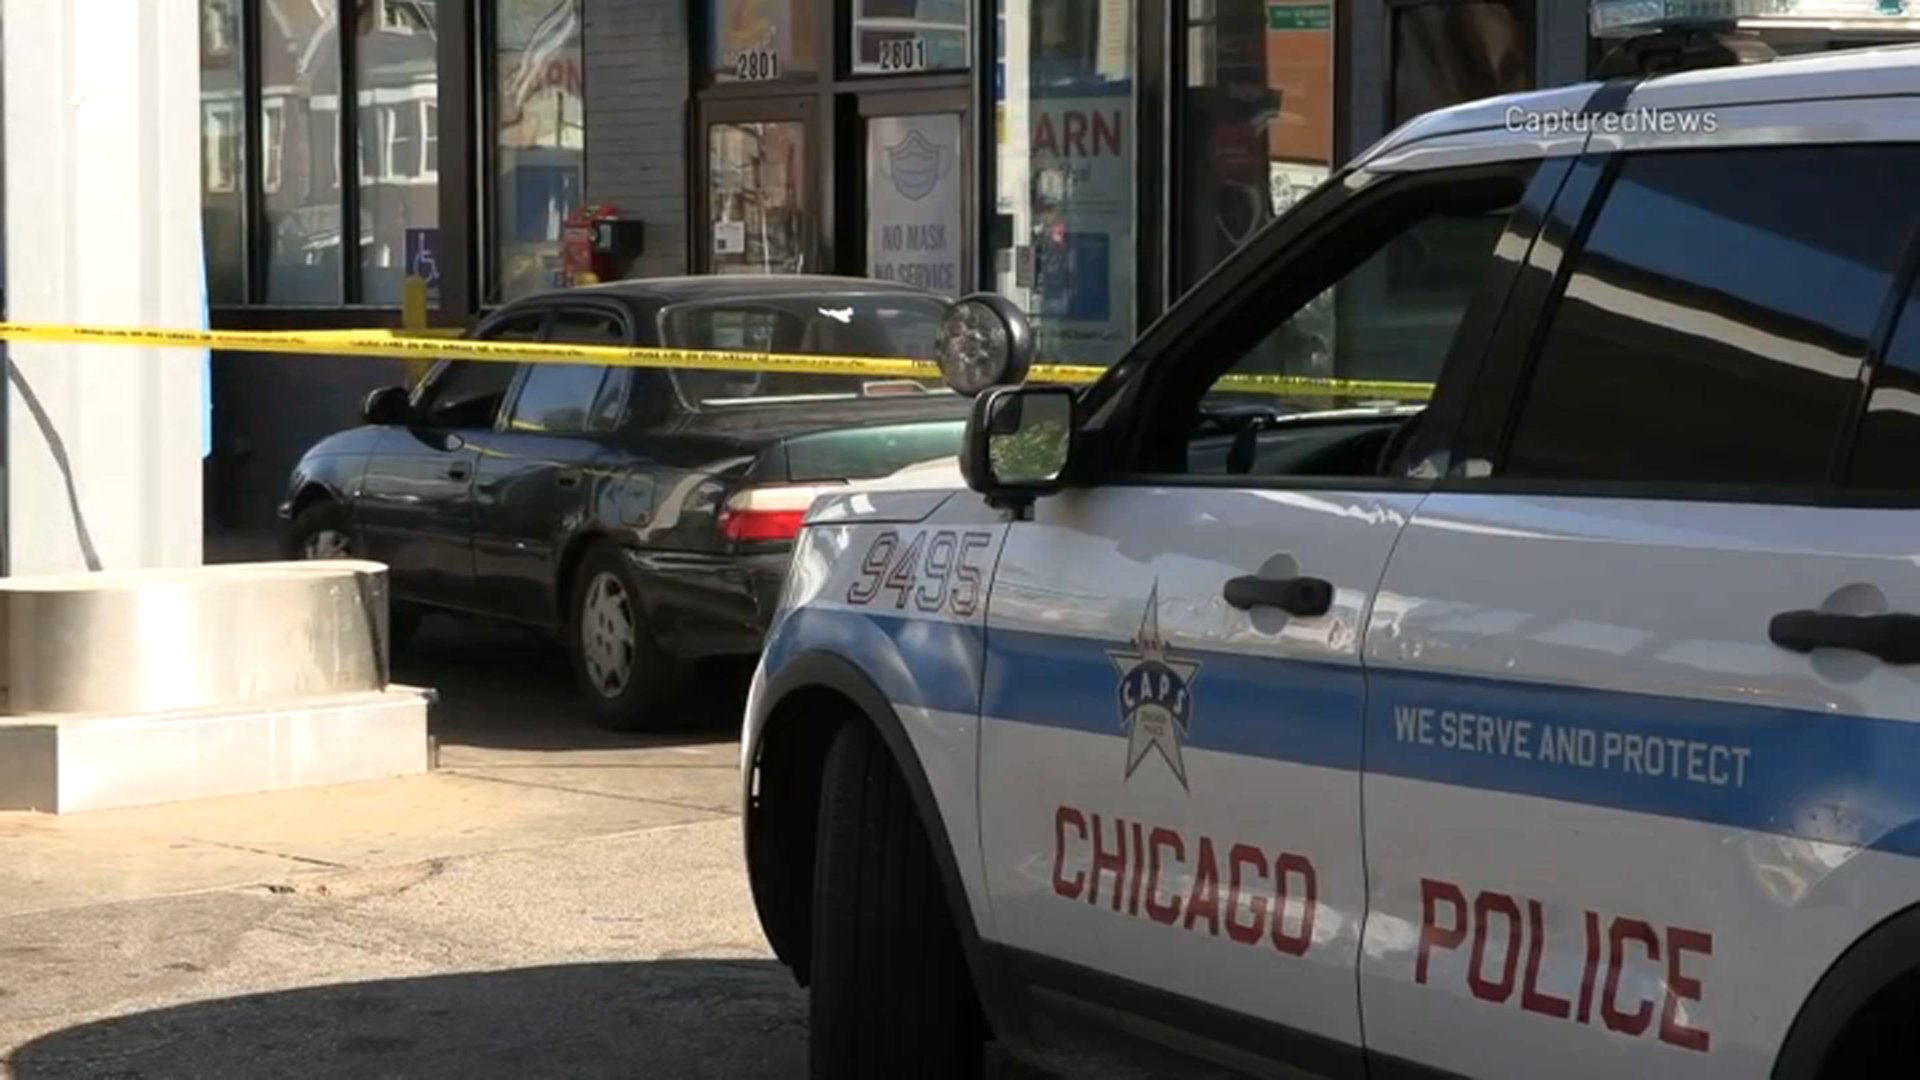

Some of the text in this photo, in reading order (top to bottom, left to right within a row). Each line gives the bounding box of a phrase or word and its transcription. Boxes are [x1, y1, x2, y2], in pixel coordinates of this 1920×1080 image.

[738, 52, 778, 80] 2801
[880, 40, 925, 69] 2801
[882, 224, 947, 250] NO MASK
[875, 264, 955, 288] NO SERVICE
[847, 530, 993, 616] 9495
[1123, 671, 1186, 715] CAPS
[1394, 706, 1751, 787] WE SERVE AND PROTECT
[1053, 805, 1713, 1053] CHICAGO POLICE
